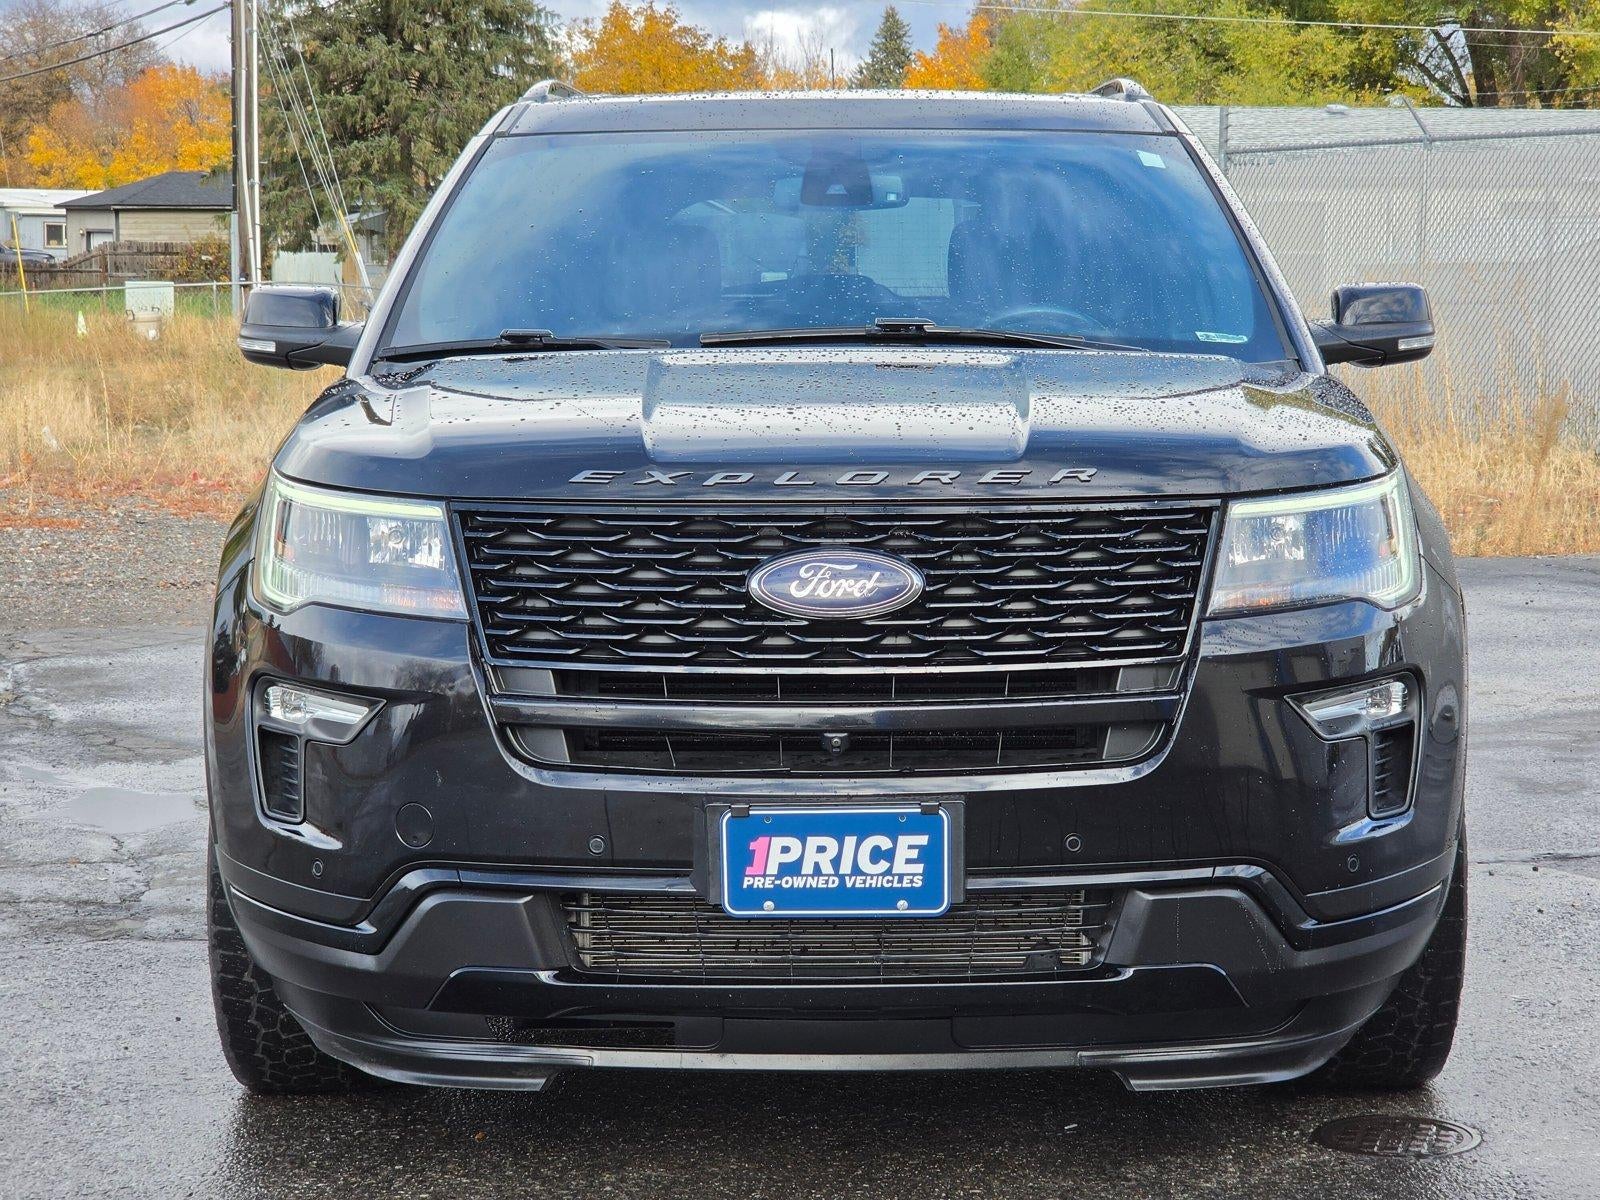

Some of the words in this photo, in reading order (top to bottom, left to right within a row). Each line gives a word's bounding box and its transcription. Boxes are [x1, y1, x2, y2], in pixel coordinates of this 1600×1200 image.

[568, 467, 1098, 486] EXPLORER
[789, 562, 880, 598] Ford
[743, 876, 839, 889] PRE-OWNED
[845, 875, 923, 888] VEHICLES
